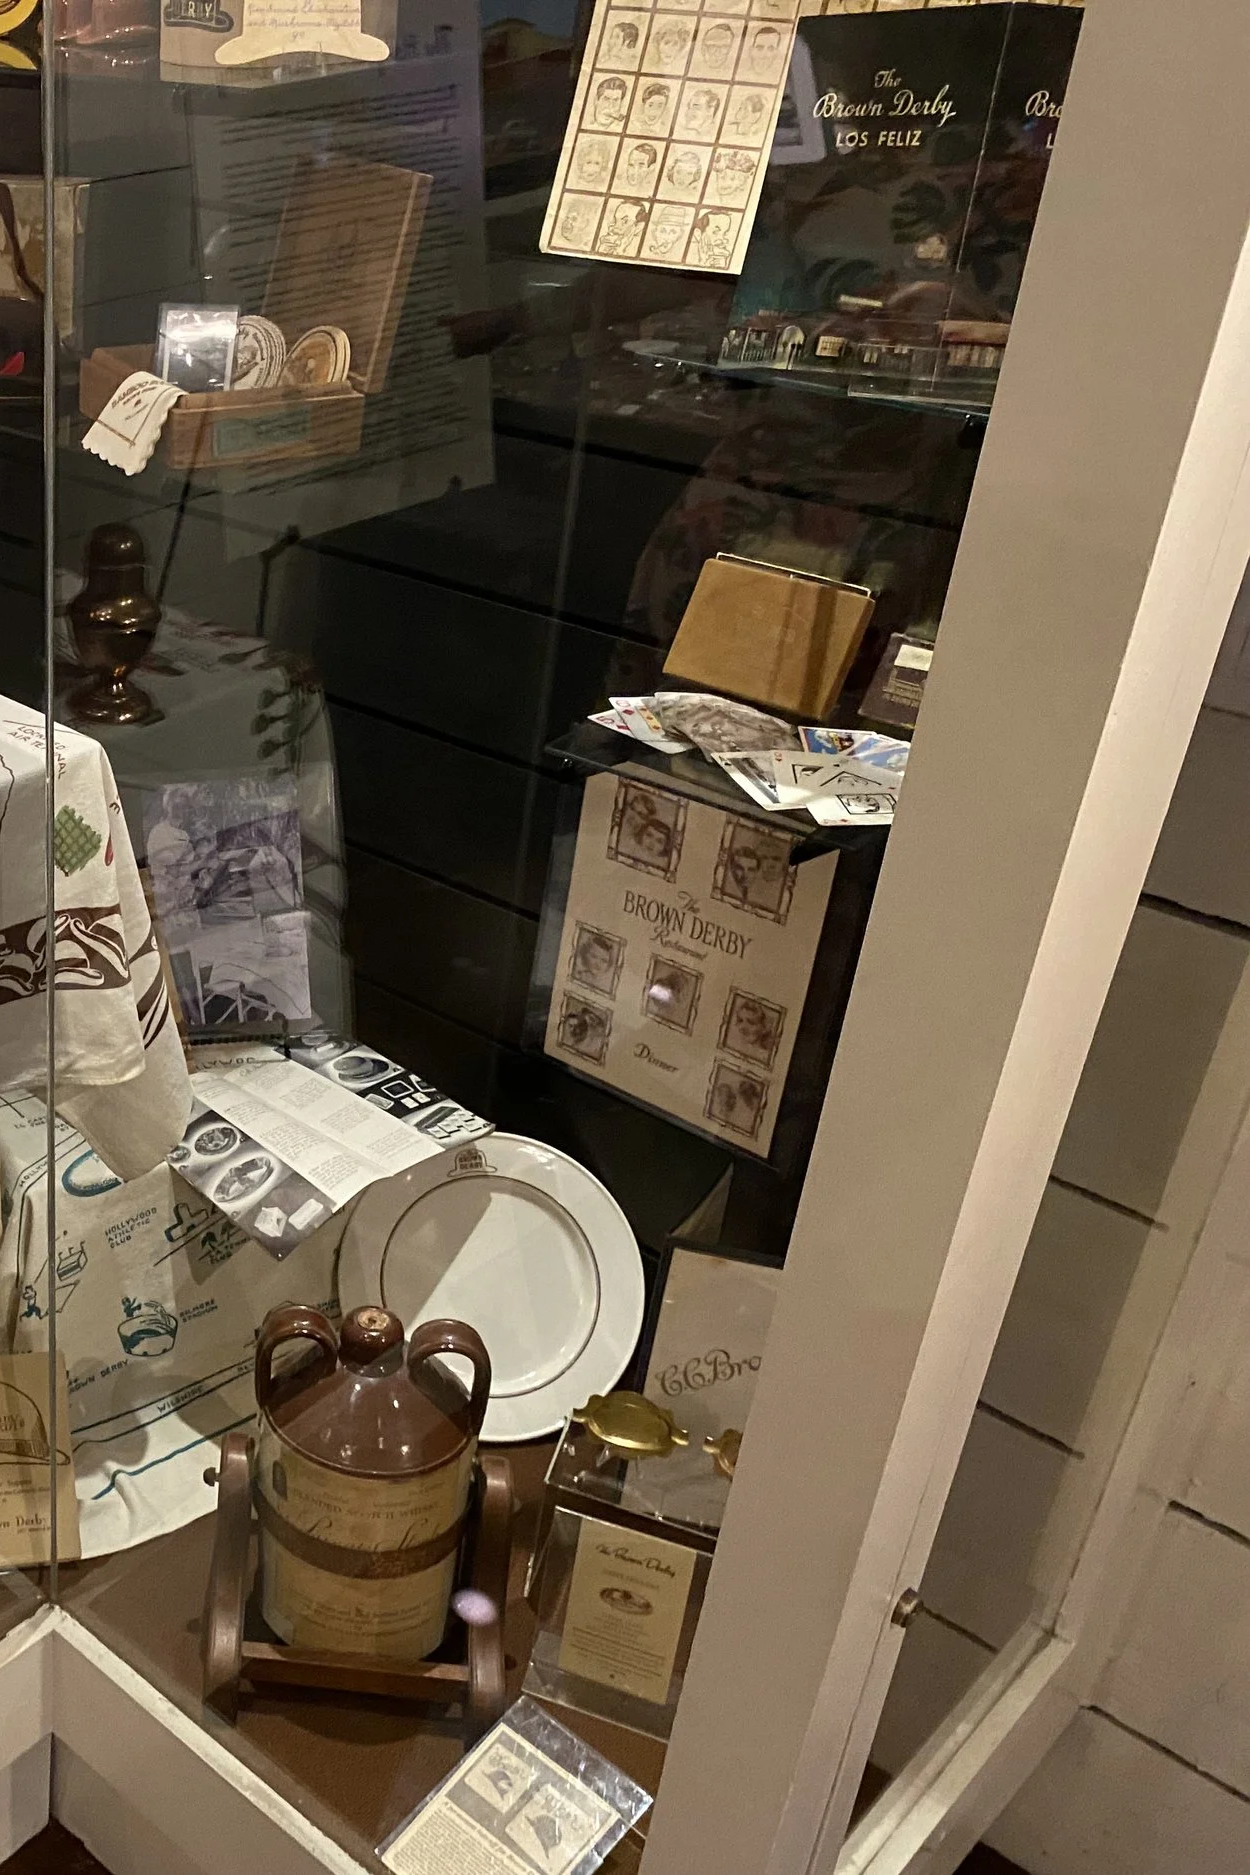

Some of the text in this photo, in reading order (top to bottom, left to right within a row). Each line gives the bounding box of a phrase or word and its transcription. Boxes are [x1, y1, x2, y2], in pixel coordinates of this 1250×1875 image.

[874, 68, 901, 88] The
[813, 84, 957, 128] Brown Derby
[835, 130, 922, 148] LOS FELIZ
[7, 731, 29, 743] AIR
[677, 890, 701, 914] The
[623, 890, 753, 960] BROWN DERBY
[633, 1042, 679, 1074] Dinner
[104, 1206, 158, 1236] HOLLYWOOD
[109, 1235, 133, 1250] CLUB
[67, 1358, 130, 1394] ROWN DERBY
[156, 1384, 204, 1414] WILSHIRE
